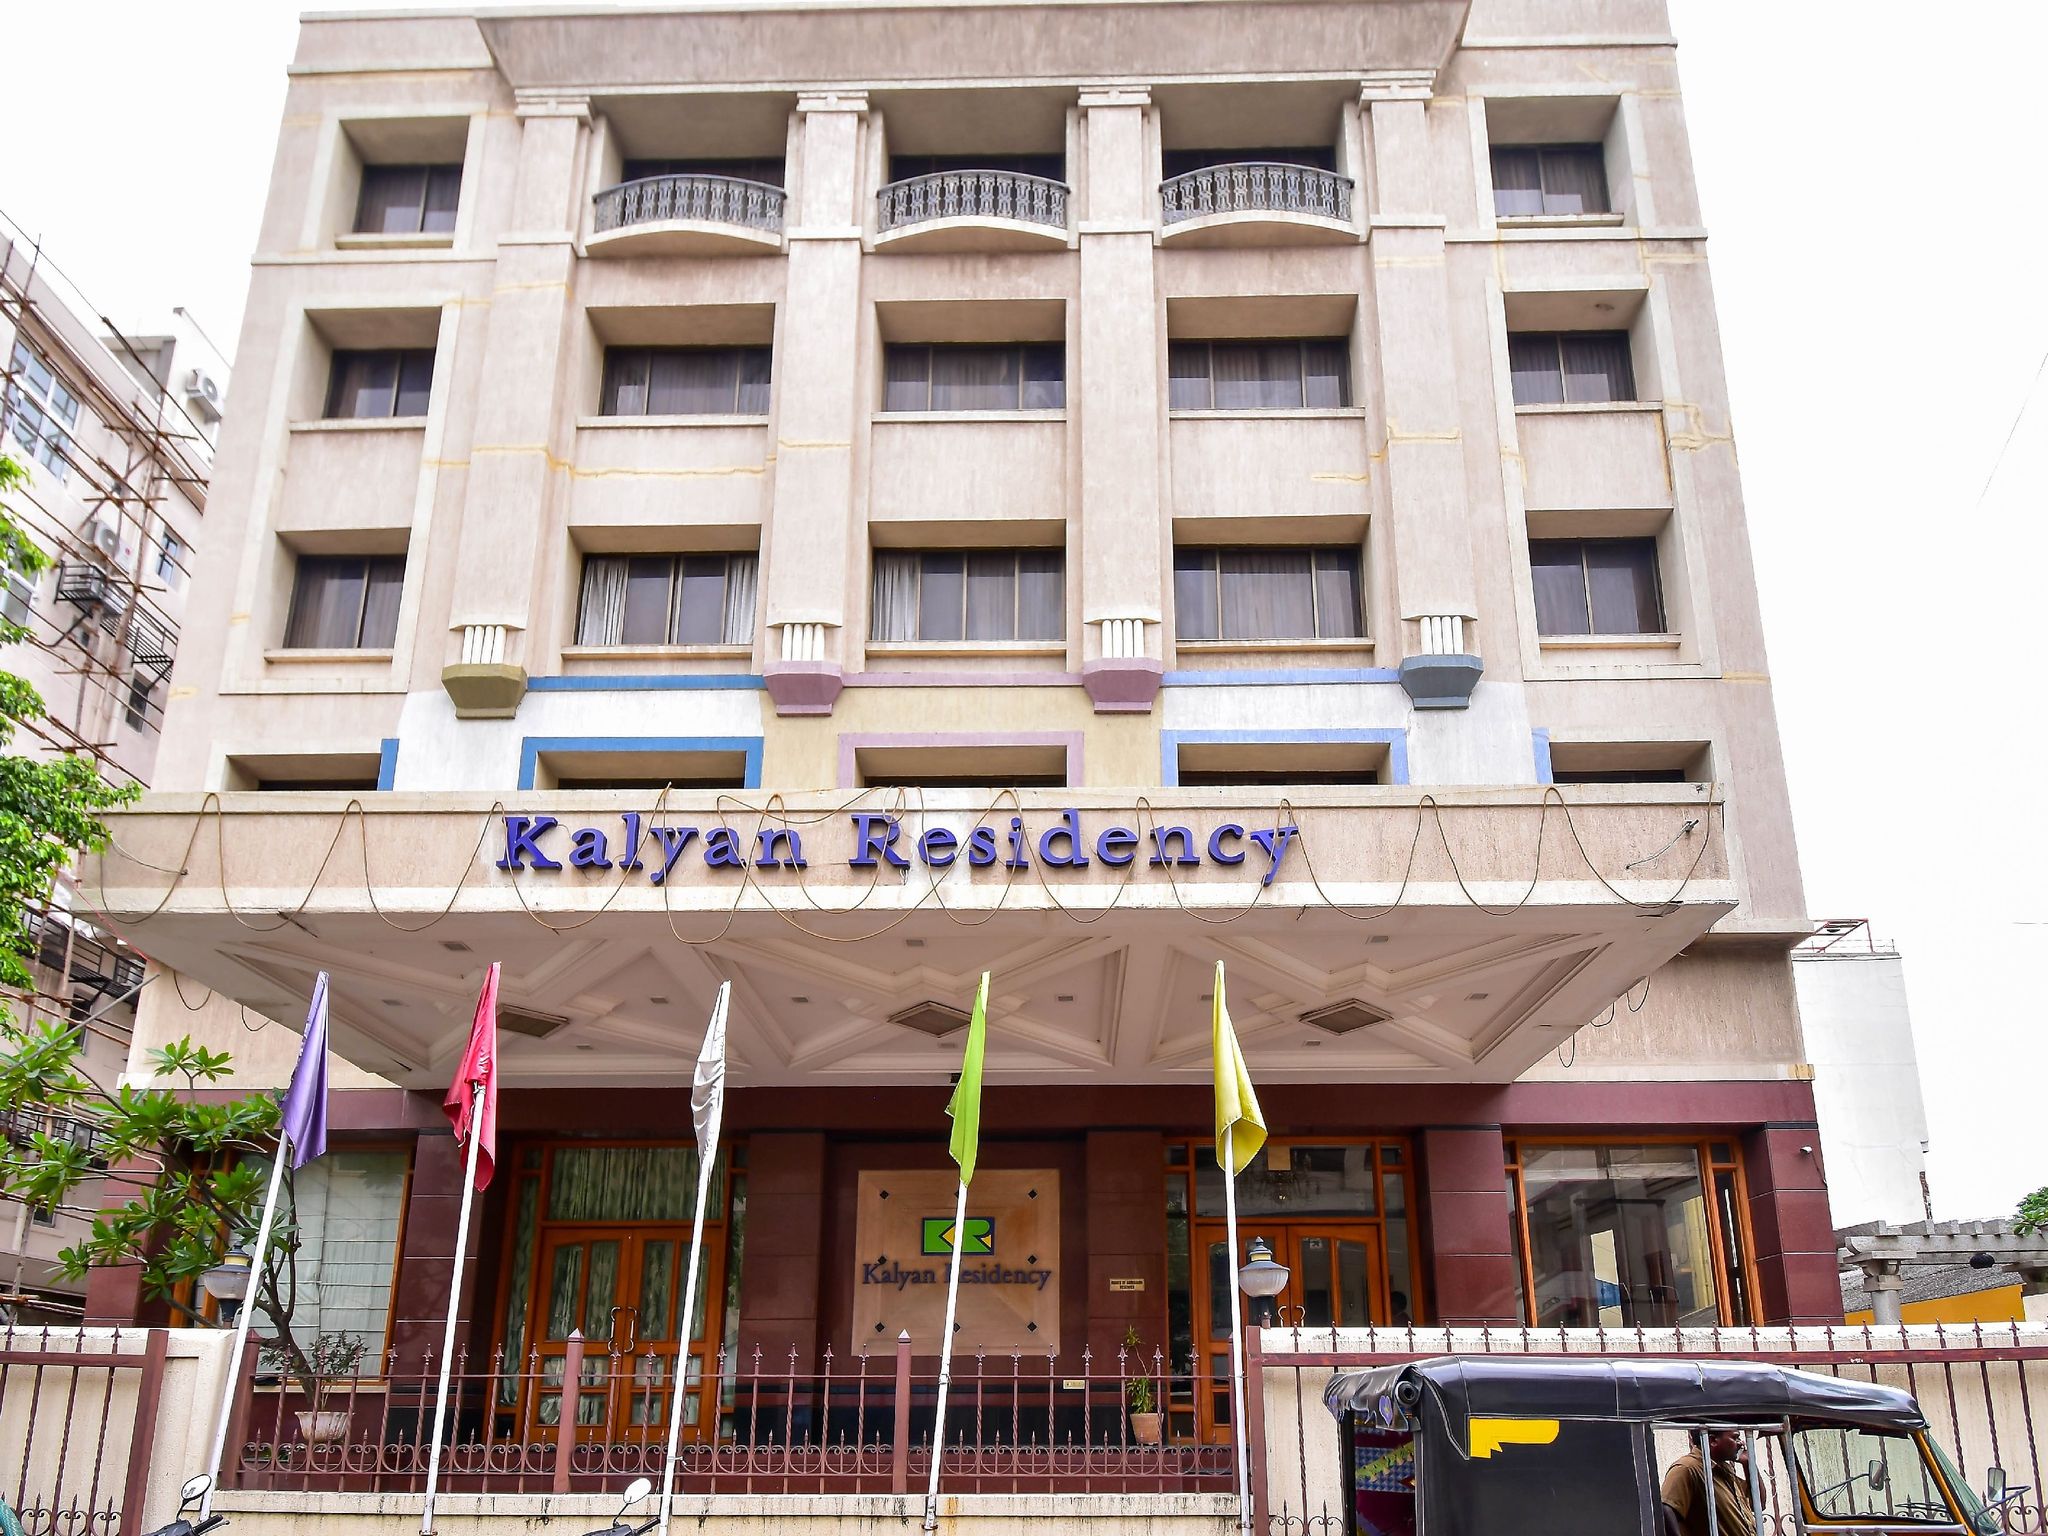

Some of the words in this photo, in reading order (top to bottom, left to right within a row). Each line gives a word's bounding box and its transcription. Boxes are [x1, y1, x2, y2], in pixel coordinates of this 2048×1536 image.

[496, 812, 808, 885] Kalyan
[848, 809, 1299, 887] Residency
[862, 1262, 937, 1291] Kalyan
